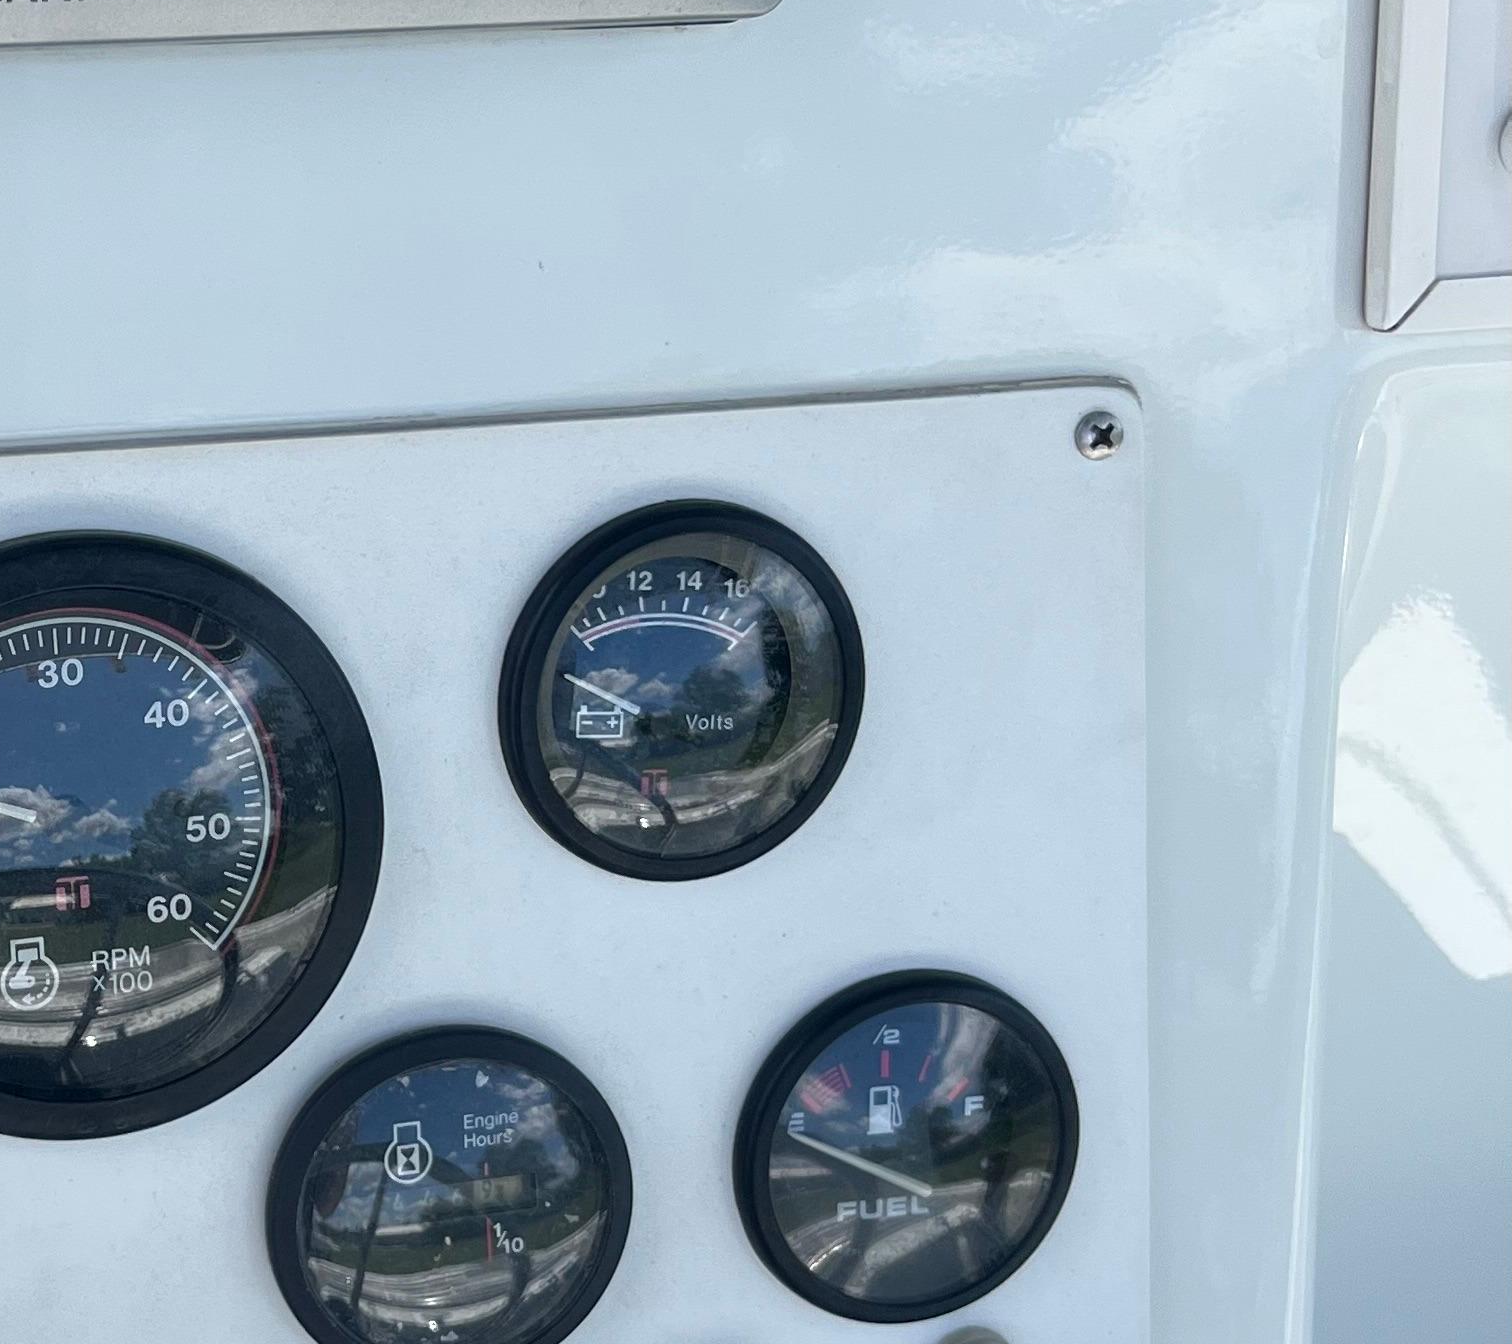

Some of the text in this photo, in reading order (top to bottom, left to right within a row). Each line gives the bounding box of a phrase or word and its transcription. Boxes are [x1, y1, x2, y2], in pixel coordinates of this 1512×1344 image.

[626, 570, 653, 592] 12
[676, 569, 703, 592] 14
[724, 577, 750, 599] 16
[37, 657, 84, 690] 30
[144, 698, 190, 730] 40
[685, 713, 735, 732] Volts
[185, 812, 231, 844] 50
[147, 893, 193, 924] 60
[91, 944, 151, 972] RPM
[93, 970, 154, 995] x100
[463, 1109, 520, 1131] Engine
[964, 1095, 985, 1117] F
[463, 1129, 514, 1149] Hours
[836, 1195, 930, 1222] FUEL
[493, 1222, 525, 1254] 1/10
